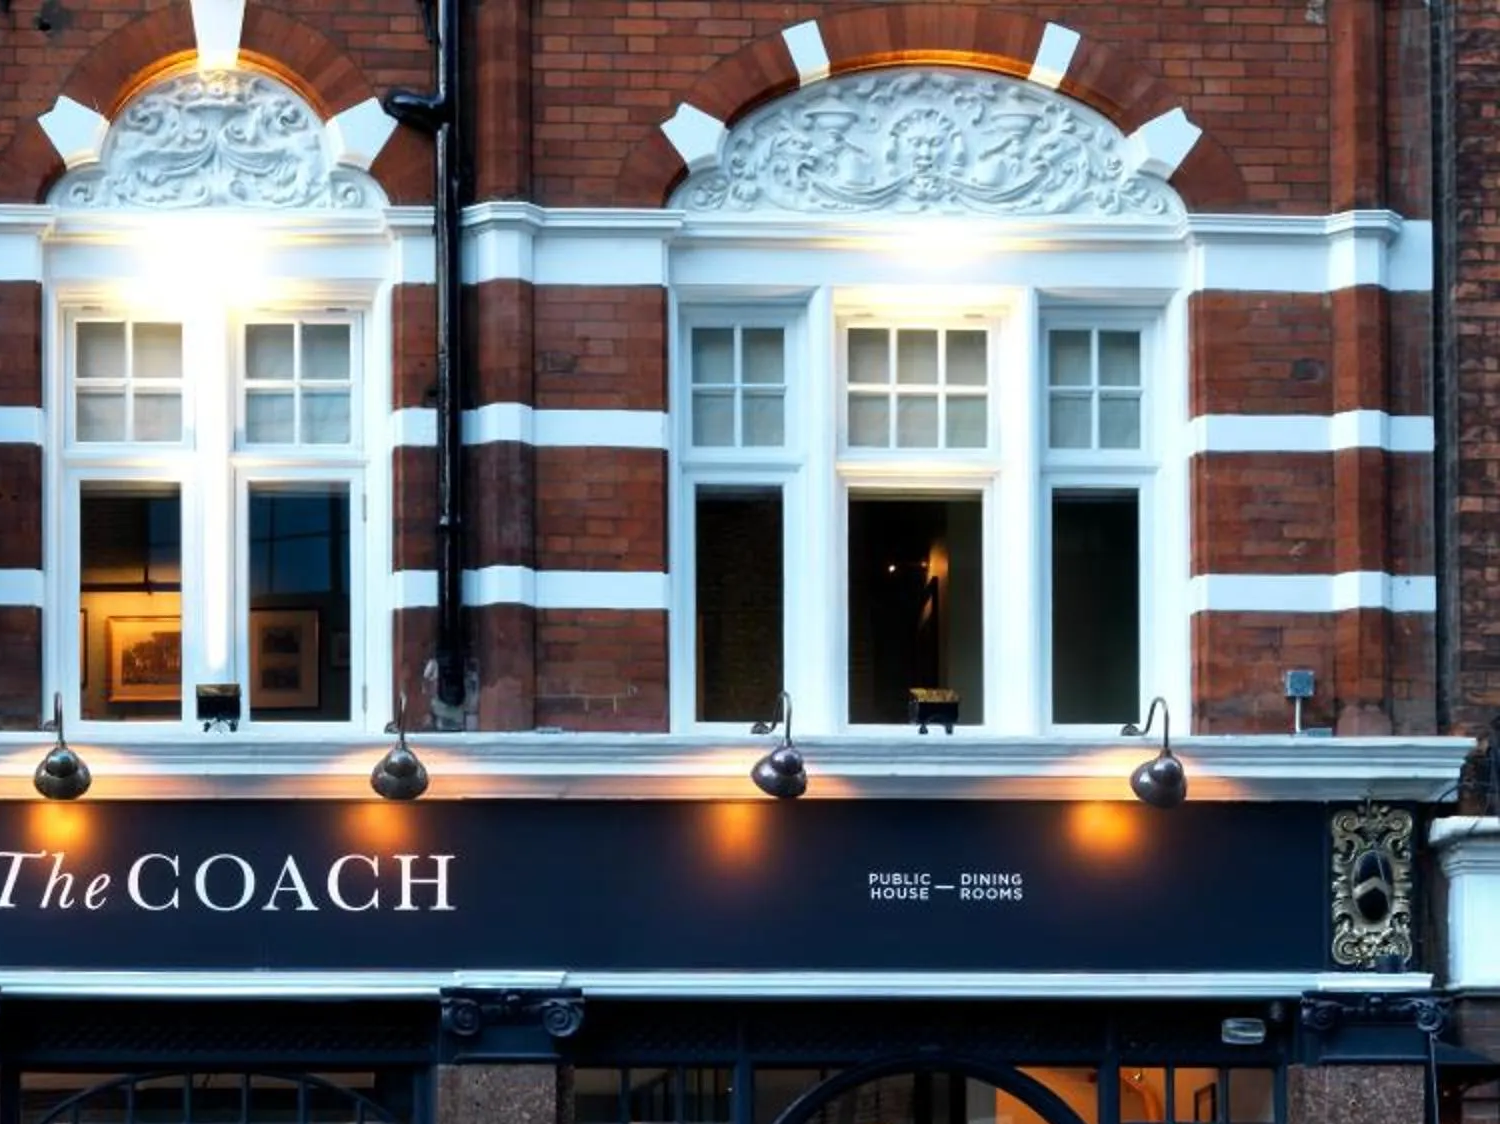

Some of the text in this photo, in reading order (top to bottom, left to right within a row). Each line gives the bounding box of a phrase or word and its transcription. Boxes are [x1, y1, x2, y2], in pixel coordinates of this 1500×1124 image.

[126, 852, 456, 912] COACH
[868, 873, 931, 885] PUBLIC
[960, 873, 1023, 885] DINING
[870, 887, 929, 900] HOUSE
[960, 887, 1023, 900] ROOMS
